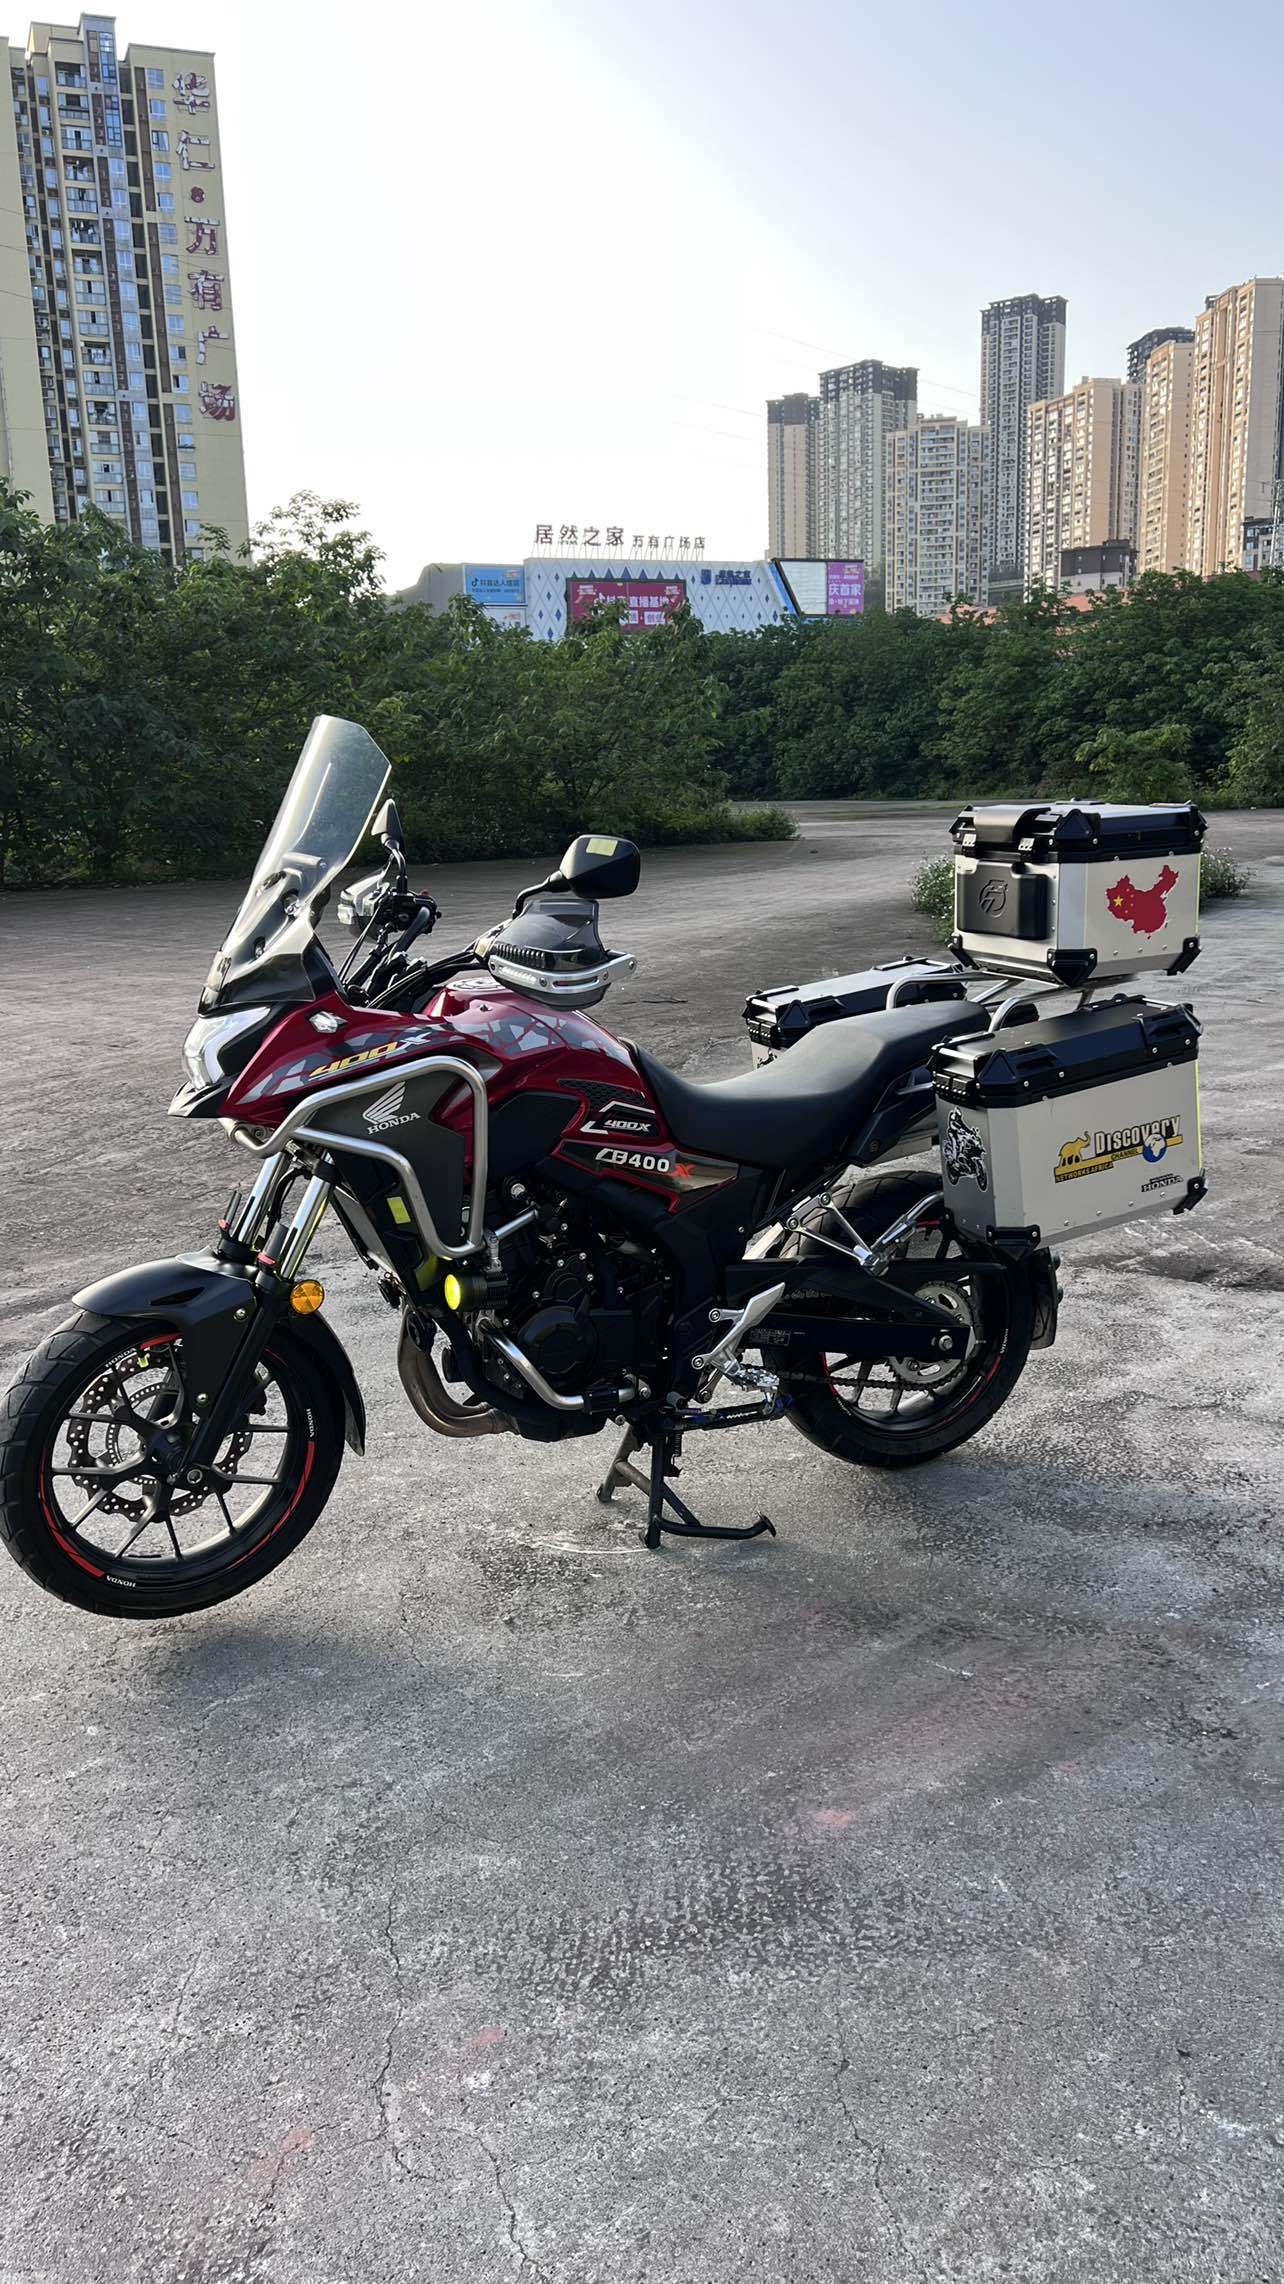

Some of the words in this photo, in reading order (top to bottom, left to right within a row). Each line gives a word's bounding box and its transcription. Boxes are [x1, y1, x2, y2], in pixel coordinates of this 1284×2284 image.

[534, 524, 625, 546] 居然之家
[632, 534, 706, 549] 万有广场店
[367, 1112, 421, 1134] HONDA
[603, 1120, 651, 1132] 400X
[1141, 1174, 1184, 1192] HONDA
